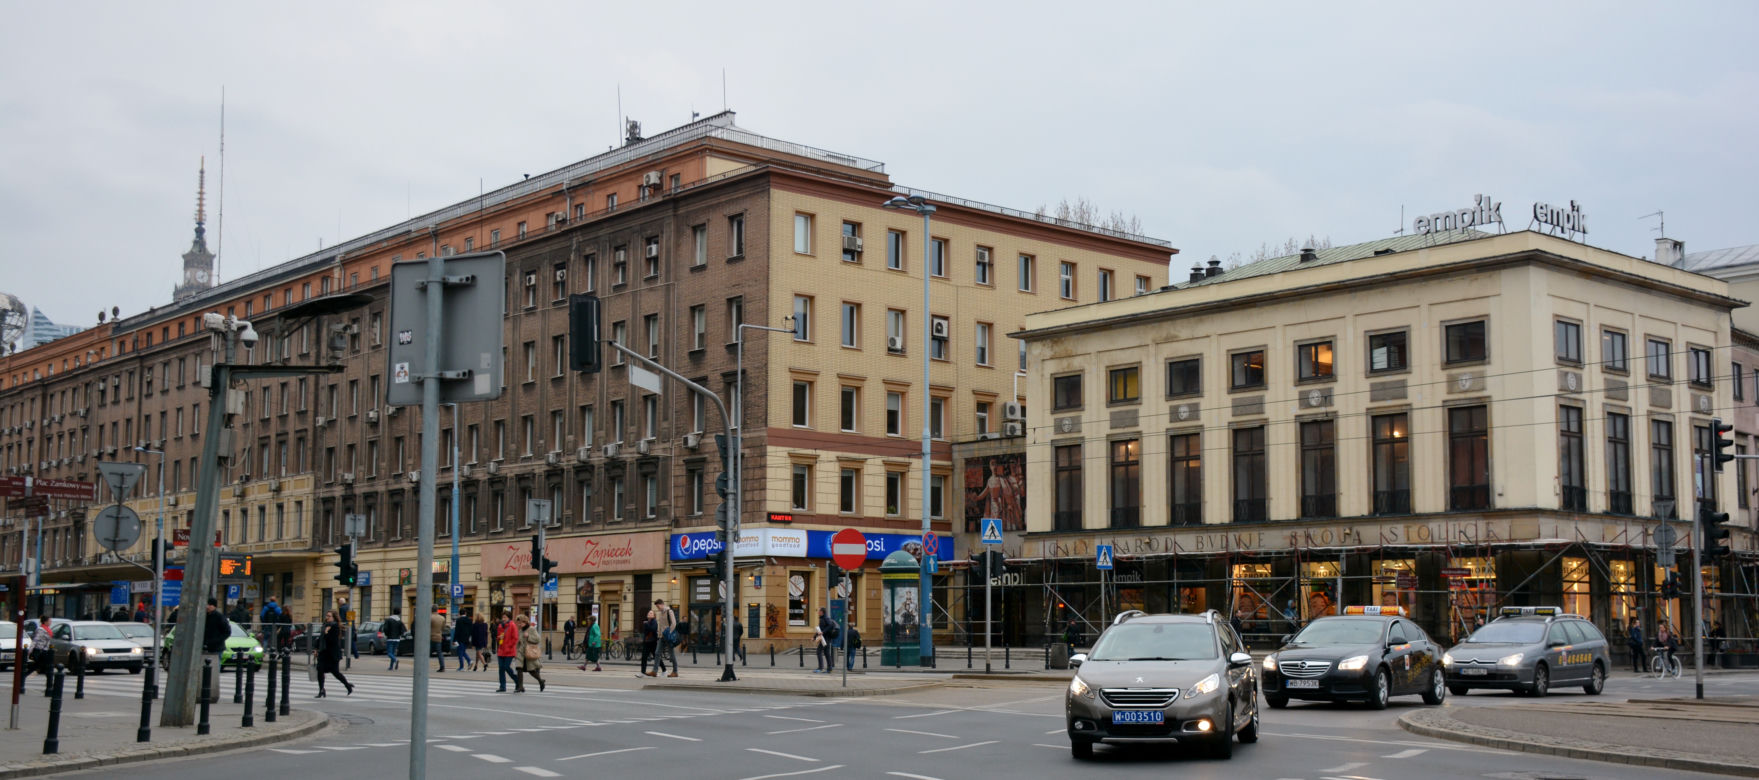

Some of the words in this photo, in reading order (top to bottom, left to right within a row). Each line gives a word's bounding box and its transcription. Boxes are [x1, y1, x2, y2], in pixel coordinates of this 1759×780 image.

[1413, 194, 1502, 235] empik
[1534, 200, 1588, 234] empik
[582, 539, 632, 568] Zapiecek
[693, 538, 720, 554] pepsi
[454, 586, 461, 596] P
